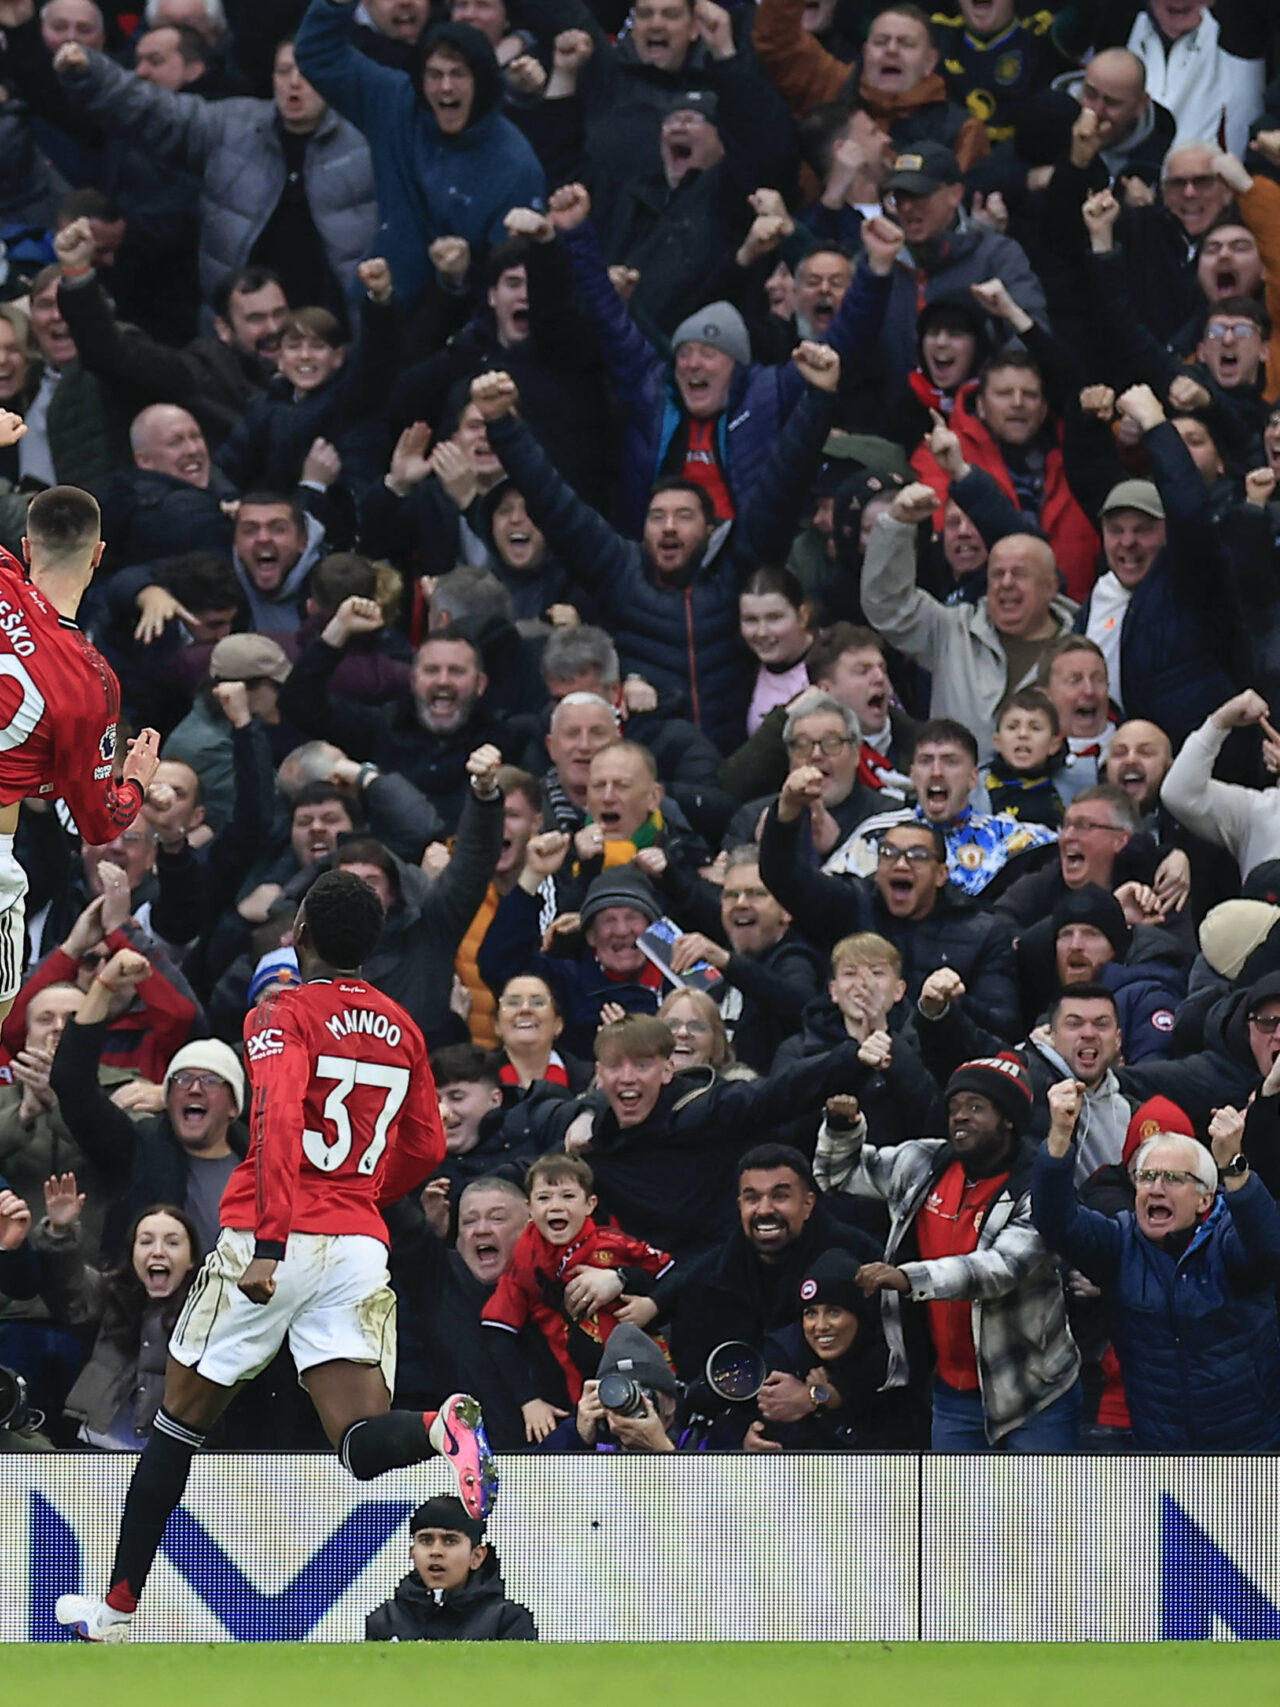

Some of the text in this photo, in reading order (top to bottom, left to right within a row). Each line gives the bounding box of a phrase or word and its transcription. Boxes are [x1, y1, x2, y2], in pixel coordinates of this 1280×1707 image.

[247, 1029, 285, 1056] XC
[325, 1009, 402, 1048] MAINOO
[302, 1055, 410, 1175] 37
